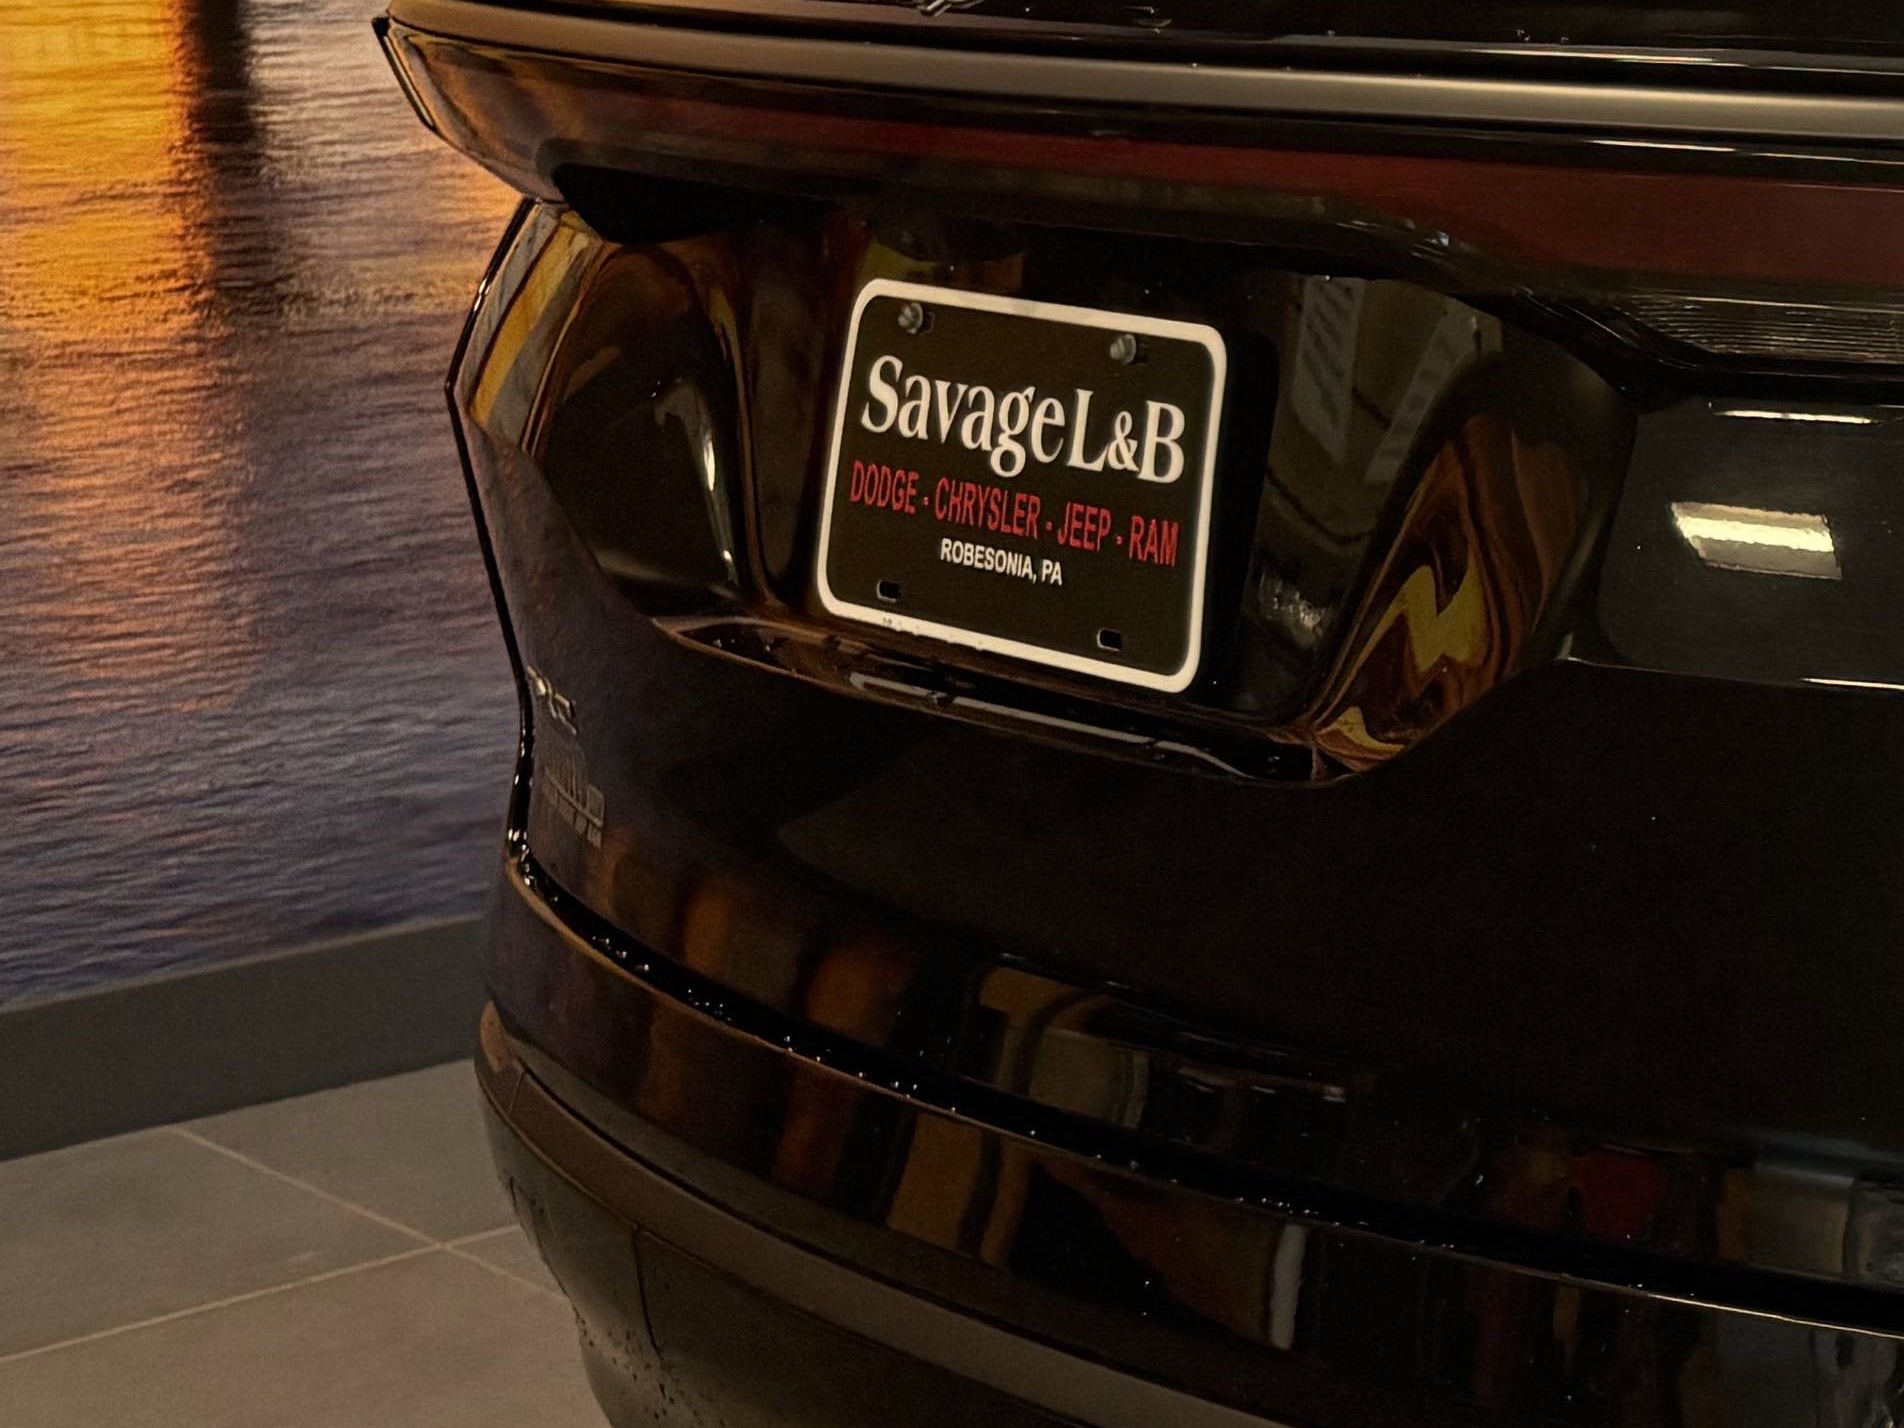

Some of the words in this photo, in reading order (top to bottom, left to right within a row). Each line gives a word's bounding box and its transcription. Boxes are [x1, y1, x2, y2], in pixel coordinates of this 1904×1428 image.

[861, 355, 1065, 477] Savage
[1067, 389, 1185, 483] L&B
[849, 460, 919, 514] DODGE
[934, 477, 1041, 539] CHRYSLER
[1056, 502, 1111, 551] JEEP
[1129, 515, 1178, 566] RAM
[940, 538, 1038, 583] ROBESONIA,
[1041, 559, 1063, 585] PA
